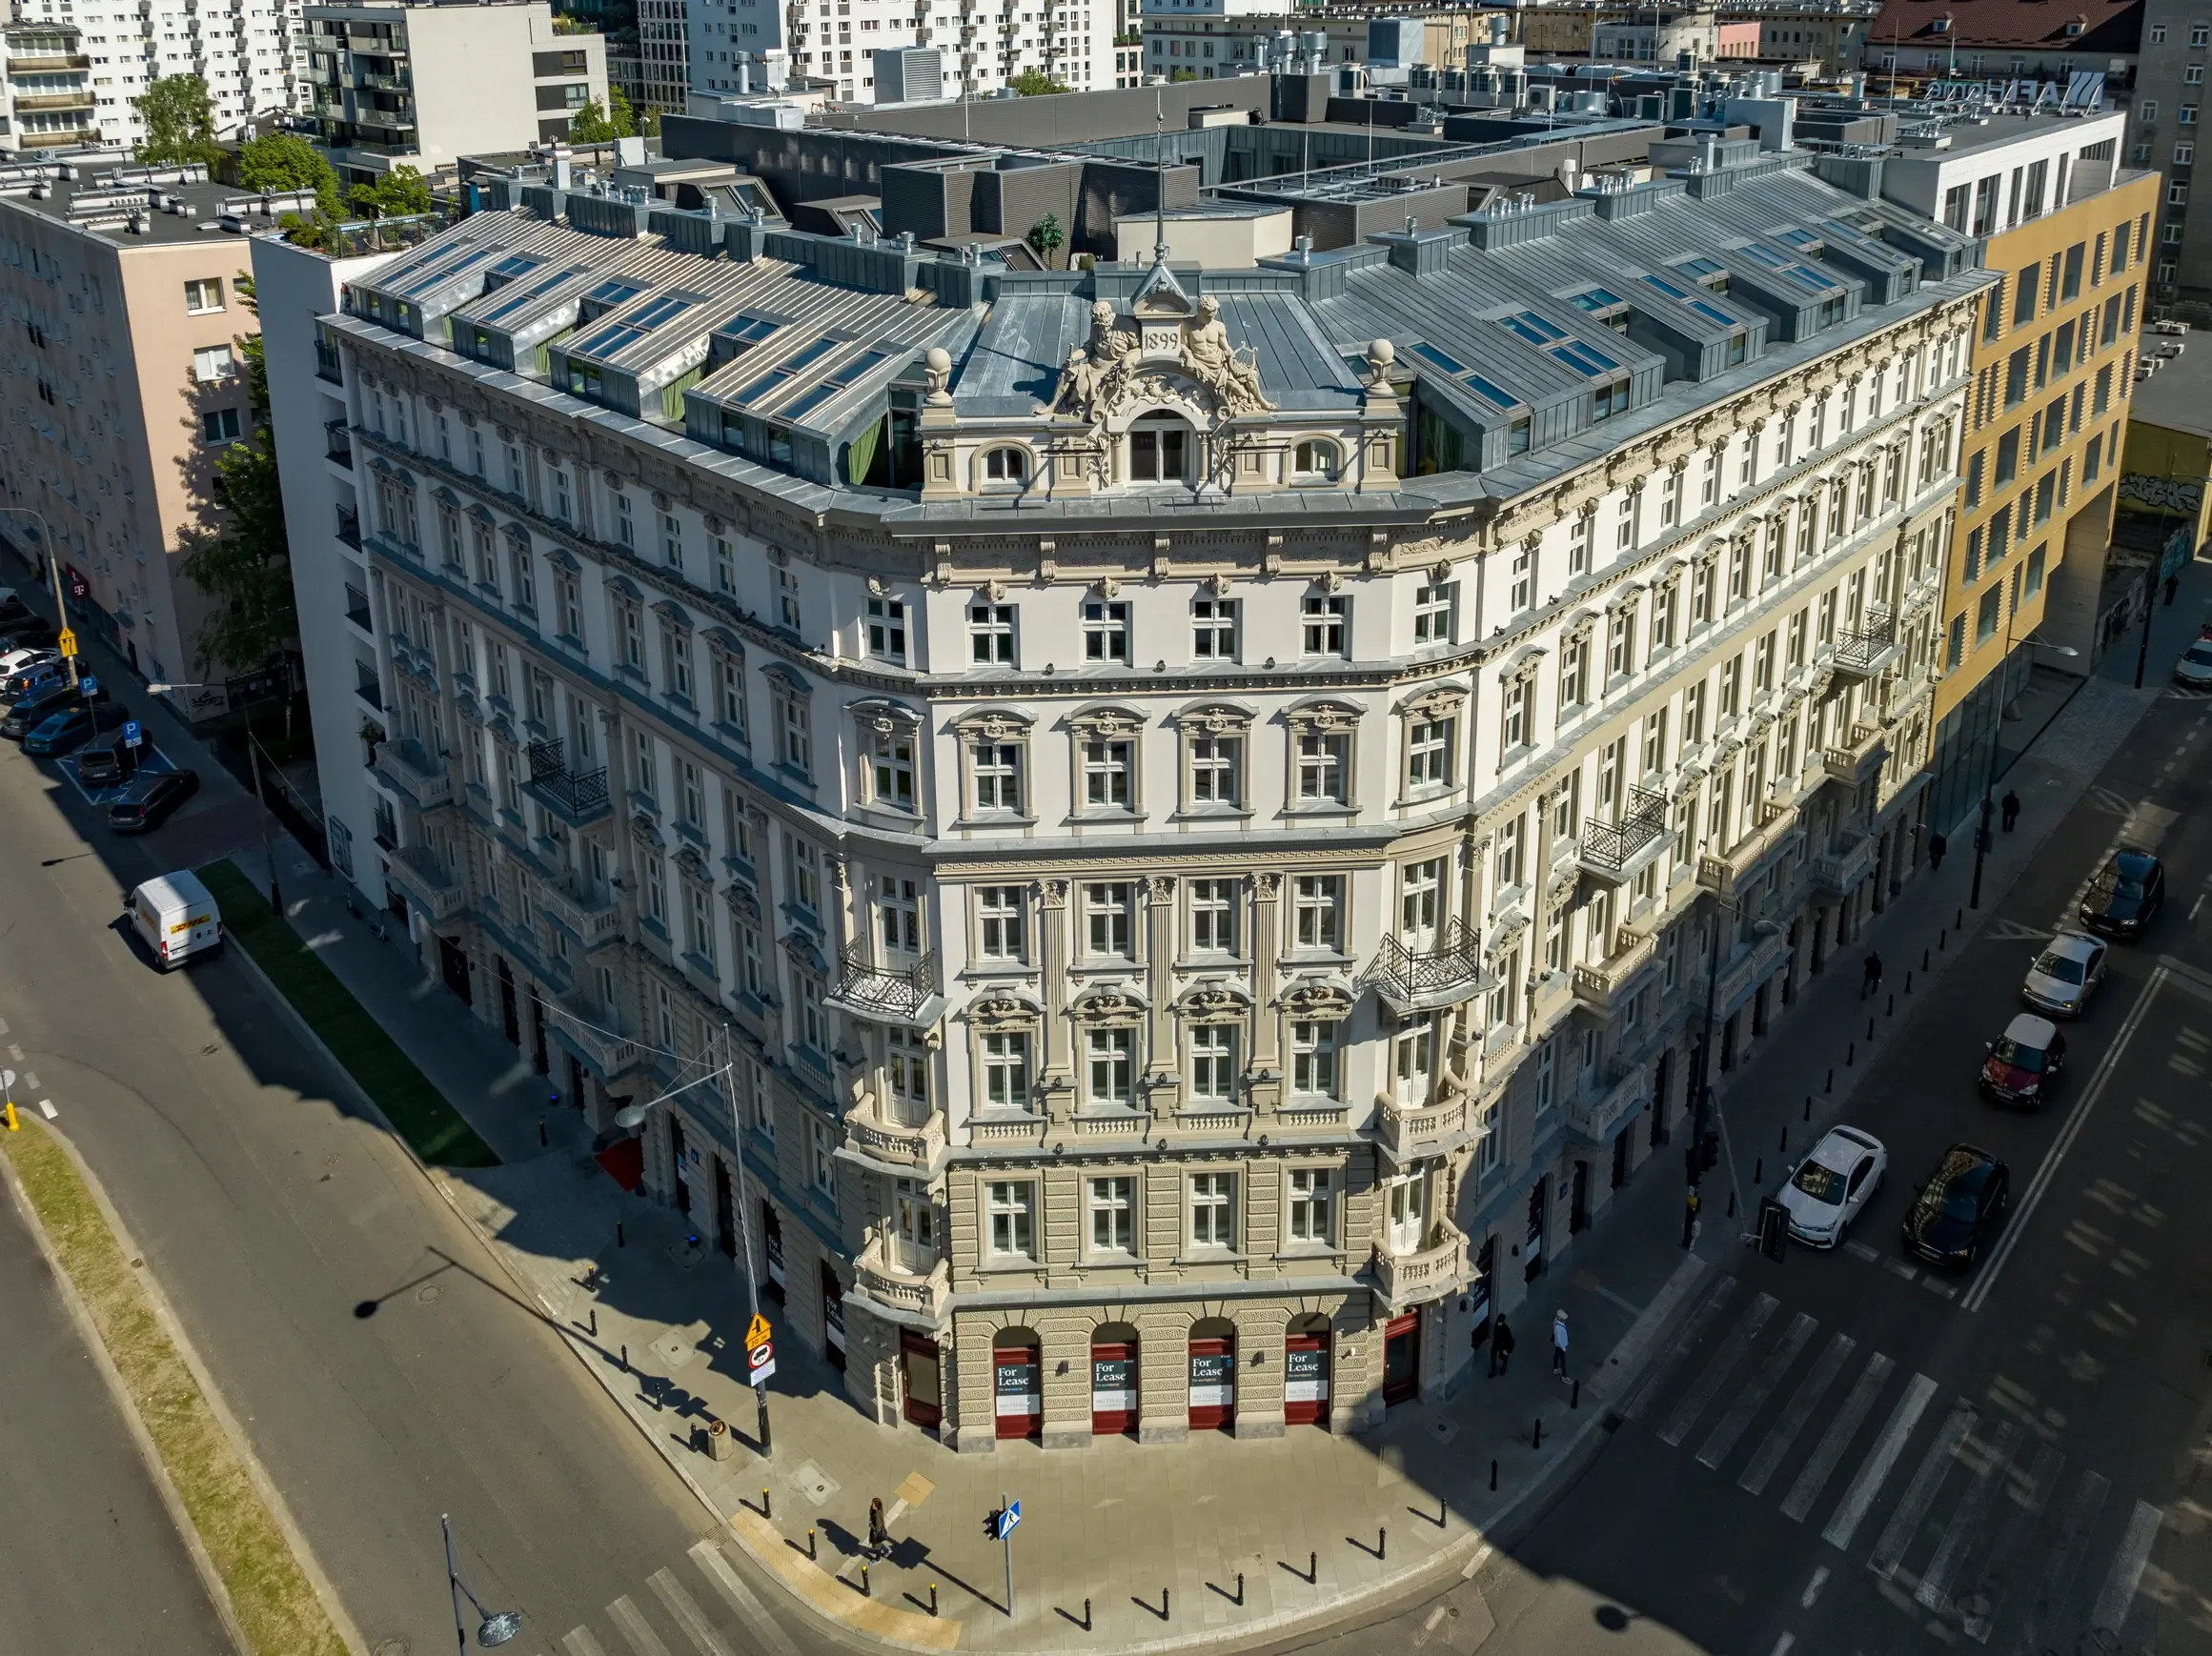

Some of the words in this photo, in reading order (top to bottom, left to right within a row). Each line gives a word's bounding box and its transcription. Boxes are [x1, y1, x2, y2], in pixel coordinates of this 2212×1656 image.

[1144, 333, 1178, 350] 1899
[83, 678, 92, 690] P
[126, 722, 136, 735] P
[1192, 1359, 1212, 1367] For
[1289, 1354, 1308, 1363] For
[1095, 1363, 1115, 1372] For
[1289, 1363, 1319, 1372] Lease
[998, 1368, 1018, 1377] For
[1192, 1368, 1223, 1377] Lease
[998, 1378, 1029, 1386] Lease
[1095, 1373, 1126, 1382] Lease
